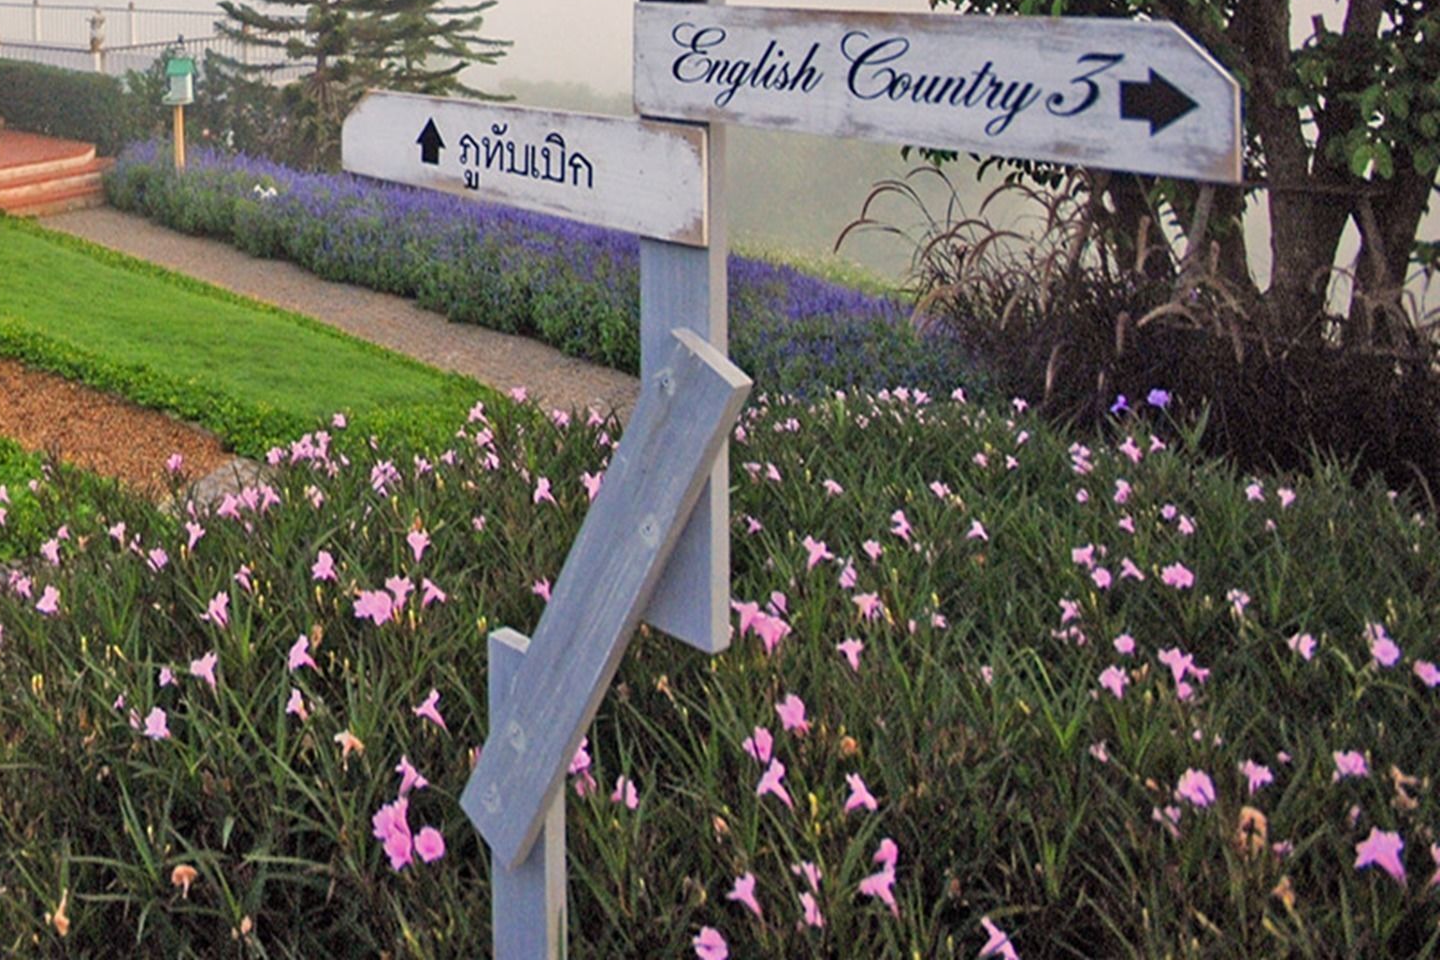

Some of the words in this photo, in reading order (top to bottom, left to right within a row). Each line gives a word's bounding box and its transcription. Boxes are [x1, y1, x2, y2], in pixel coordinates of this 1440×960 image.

[671, 22, 824, 106] English
[841, 31, 1042, 137] Country
[1045, 52, 1125, 117] 3
[460, 123, 593, 190] ภูทับเบิก
